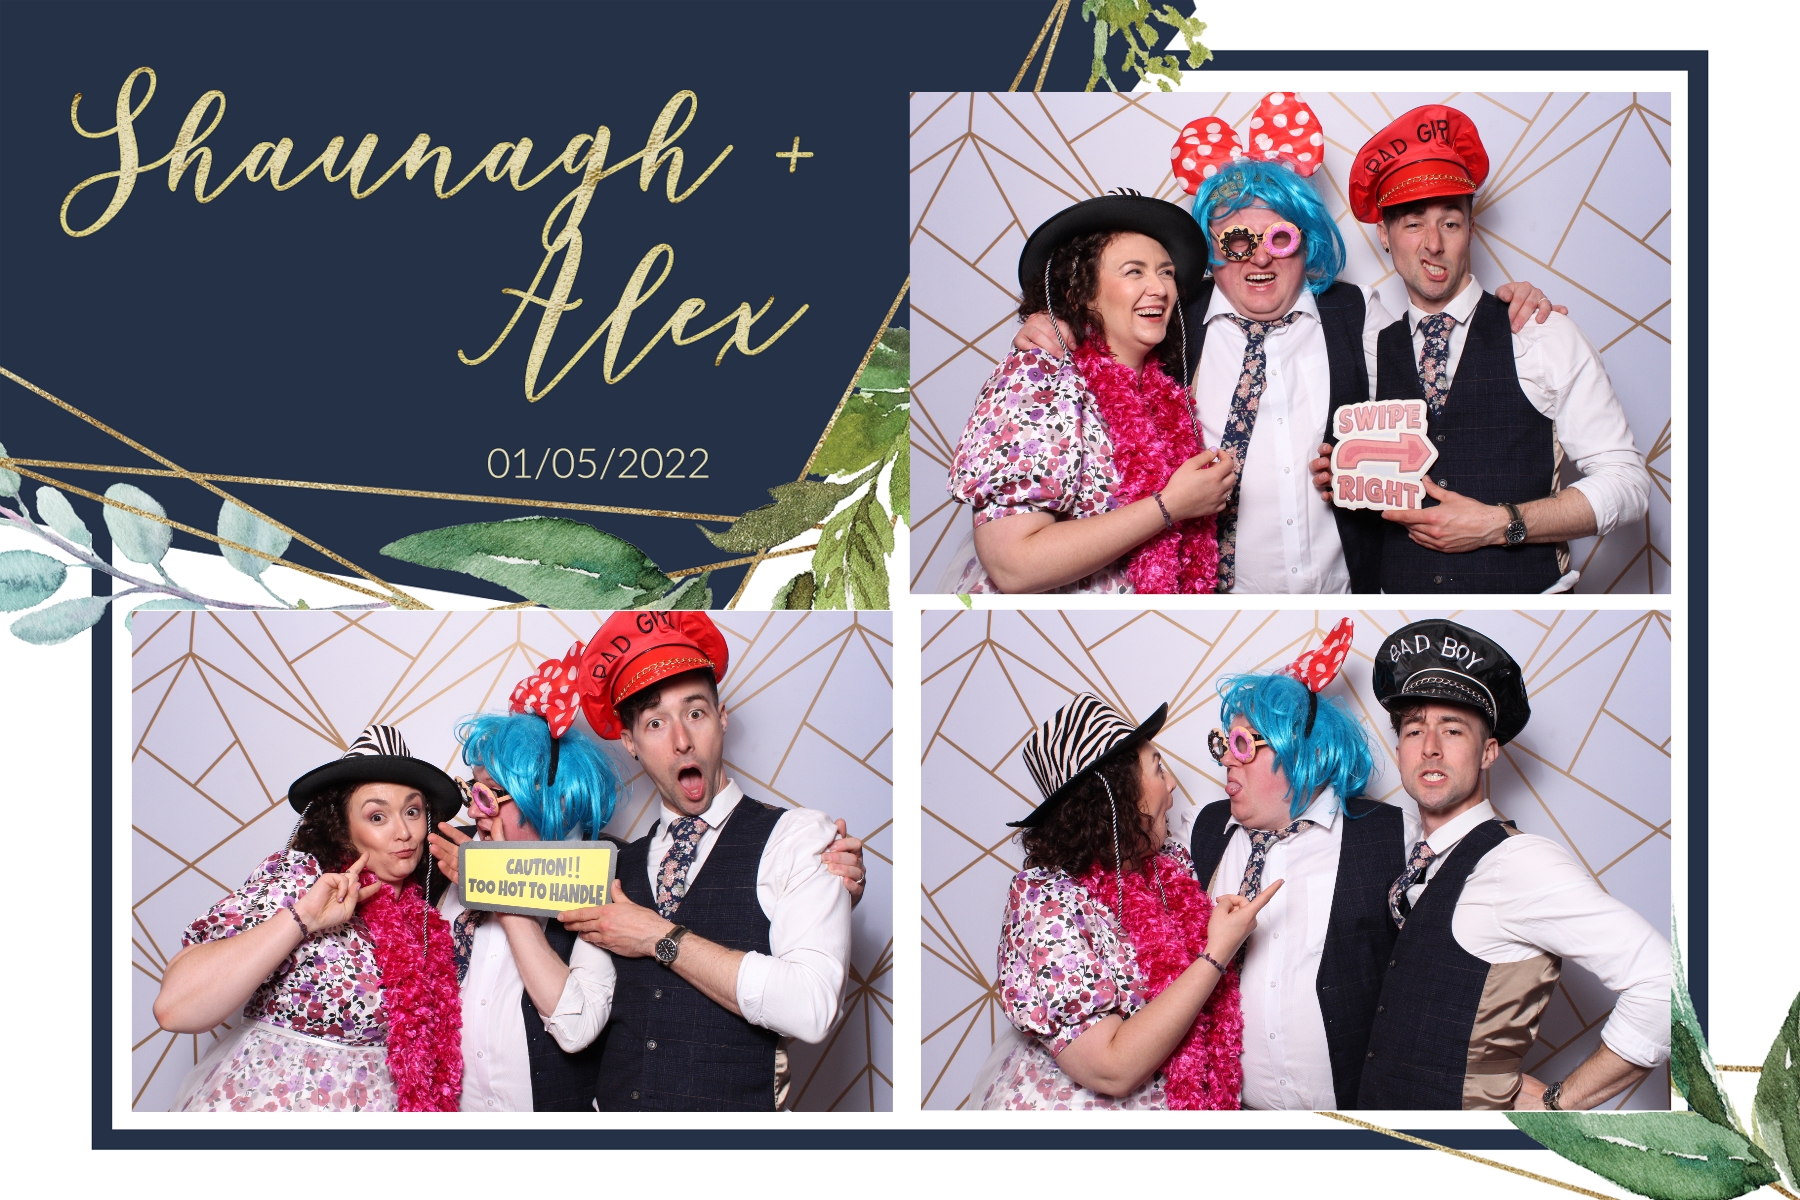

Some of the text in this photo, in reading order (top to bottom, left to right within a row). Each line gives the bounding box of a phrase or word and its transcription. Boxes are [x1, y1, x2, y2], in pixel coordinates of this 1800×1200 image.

[1416, 119, 1450, 145] GIR
[1339, 404, 1421, 434] SWIPE
[1337, 475, 1419, 509] RIGHT
[1389, 634, 1485, 670] BAD BOY
[506, 856, 581, 879] CAUTION!!
[468, 878, 605, 906] TOO HOT TO HANDLE
